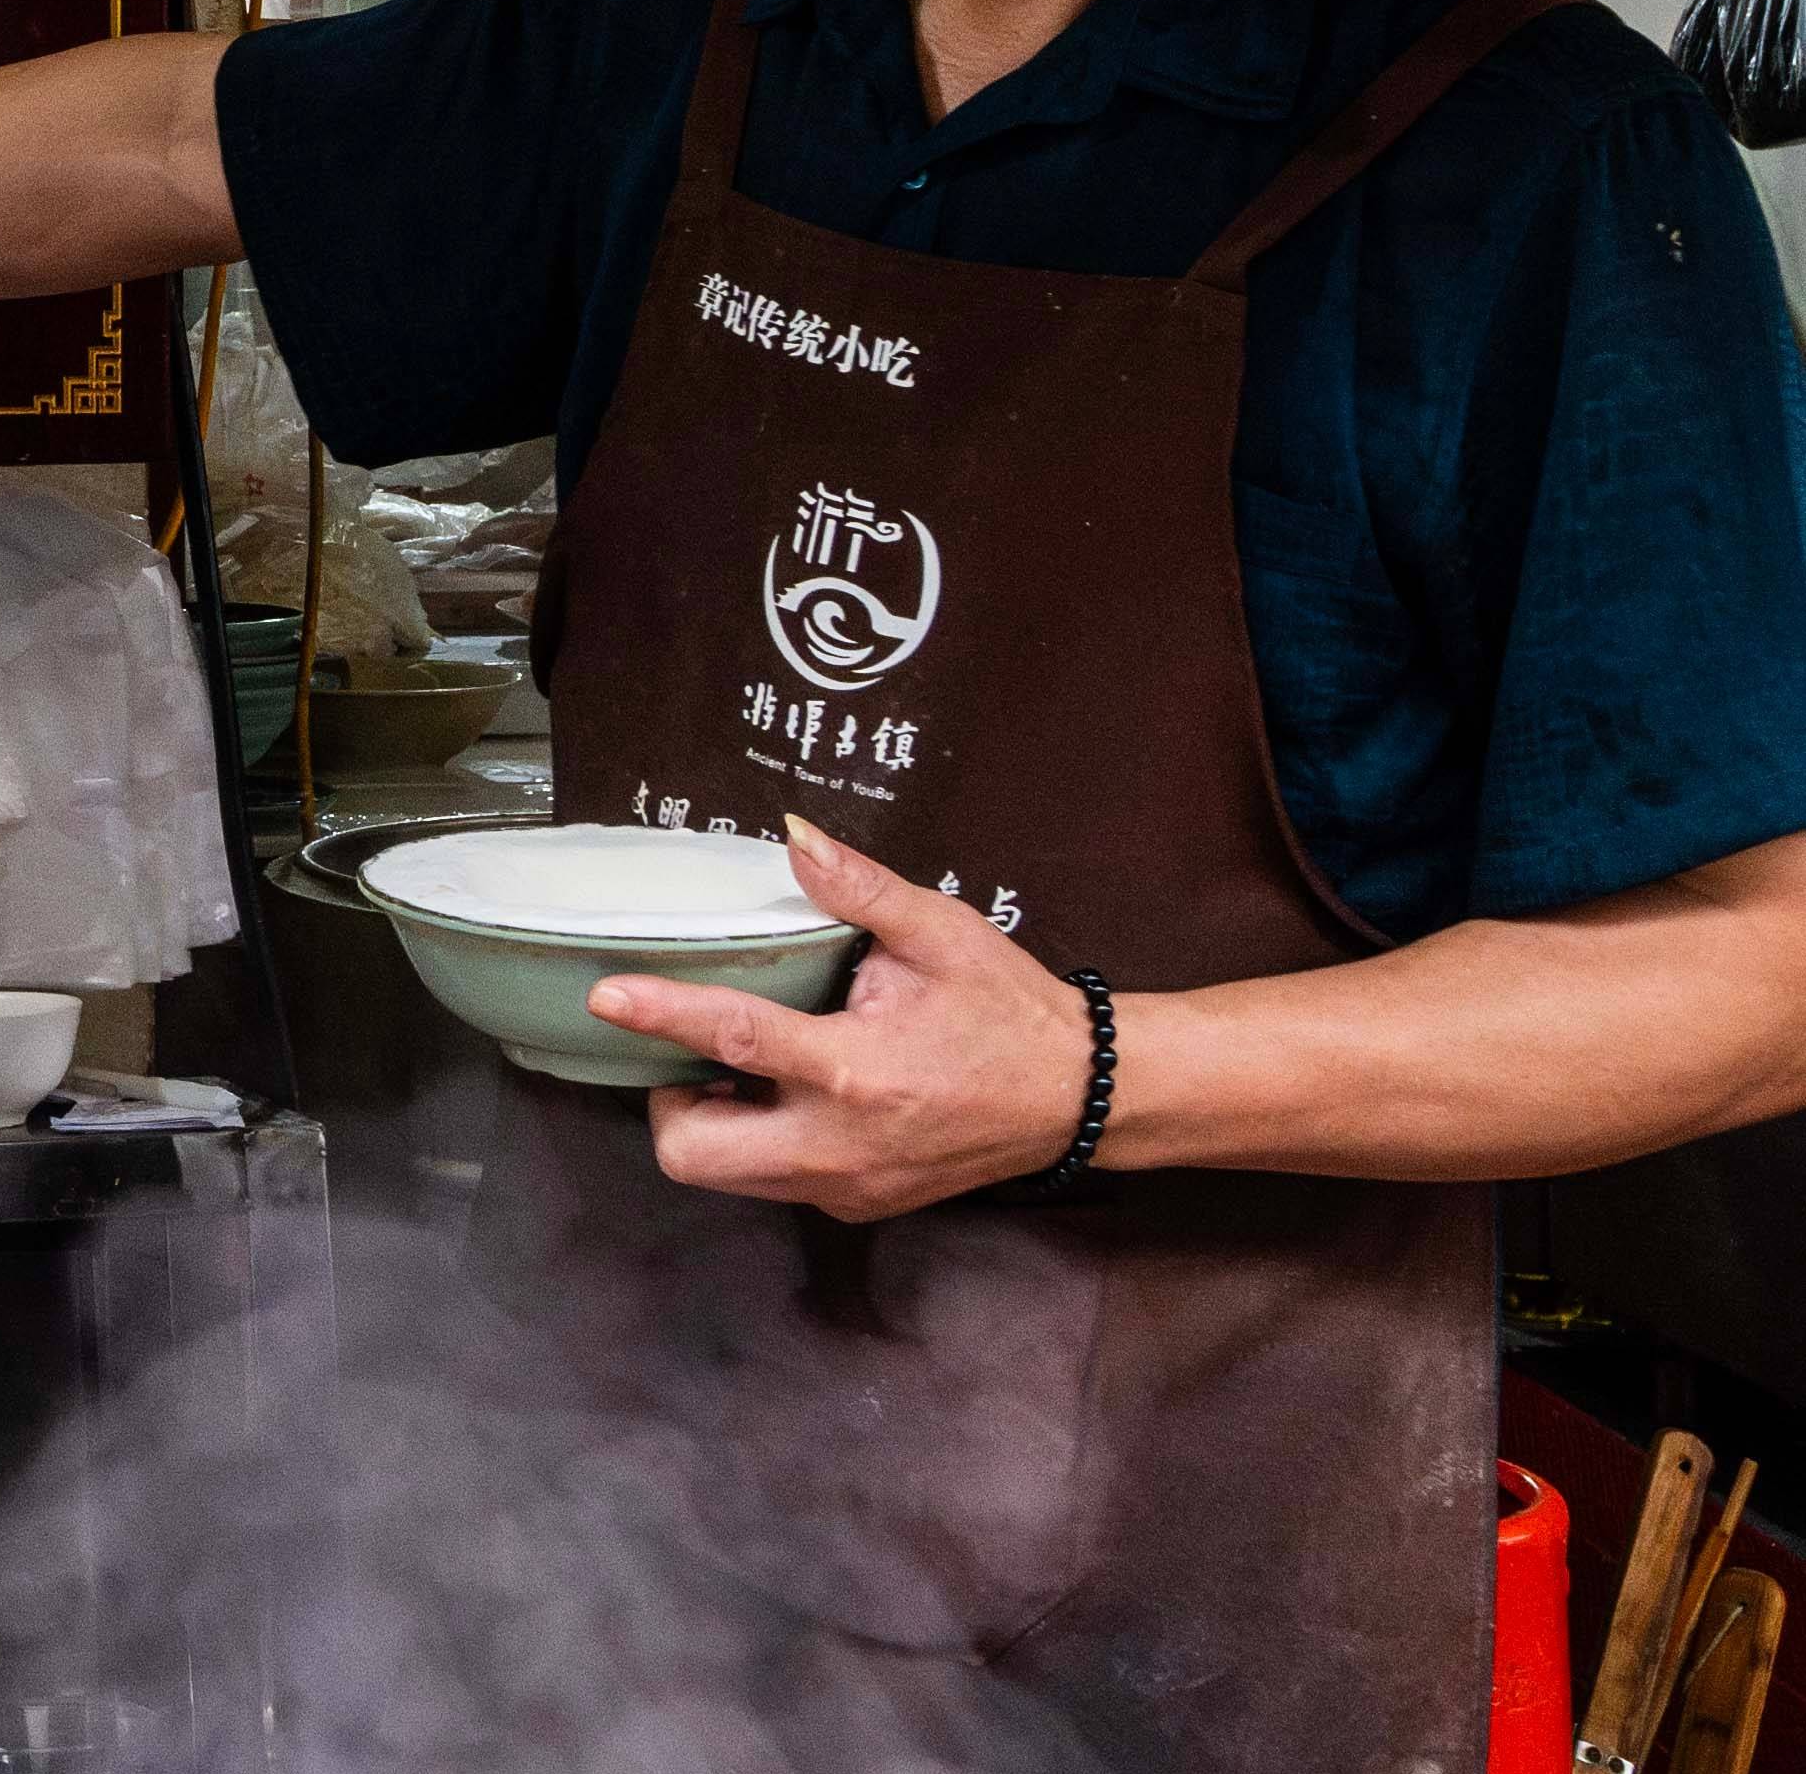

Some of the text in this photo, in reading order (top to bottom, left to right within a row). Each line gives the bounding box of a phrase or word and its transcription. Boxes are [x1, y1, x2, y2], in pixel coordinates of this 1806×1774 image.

[695, 272, 921, 389] 章记传统小吃
[745, 746, 786, 774] Ancient
[829, 776, 844, 792] of
[852, 780, 896, 803] YouBu
